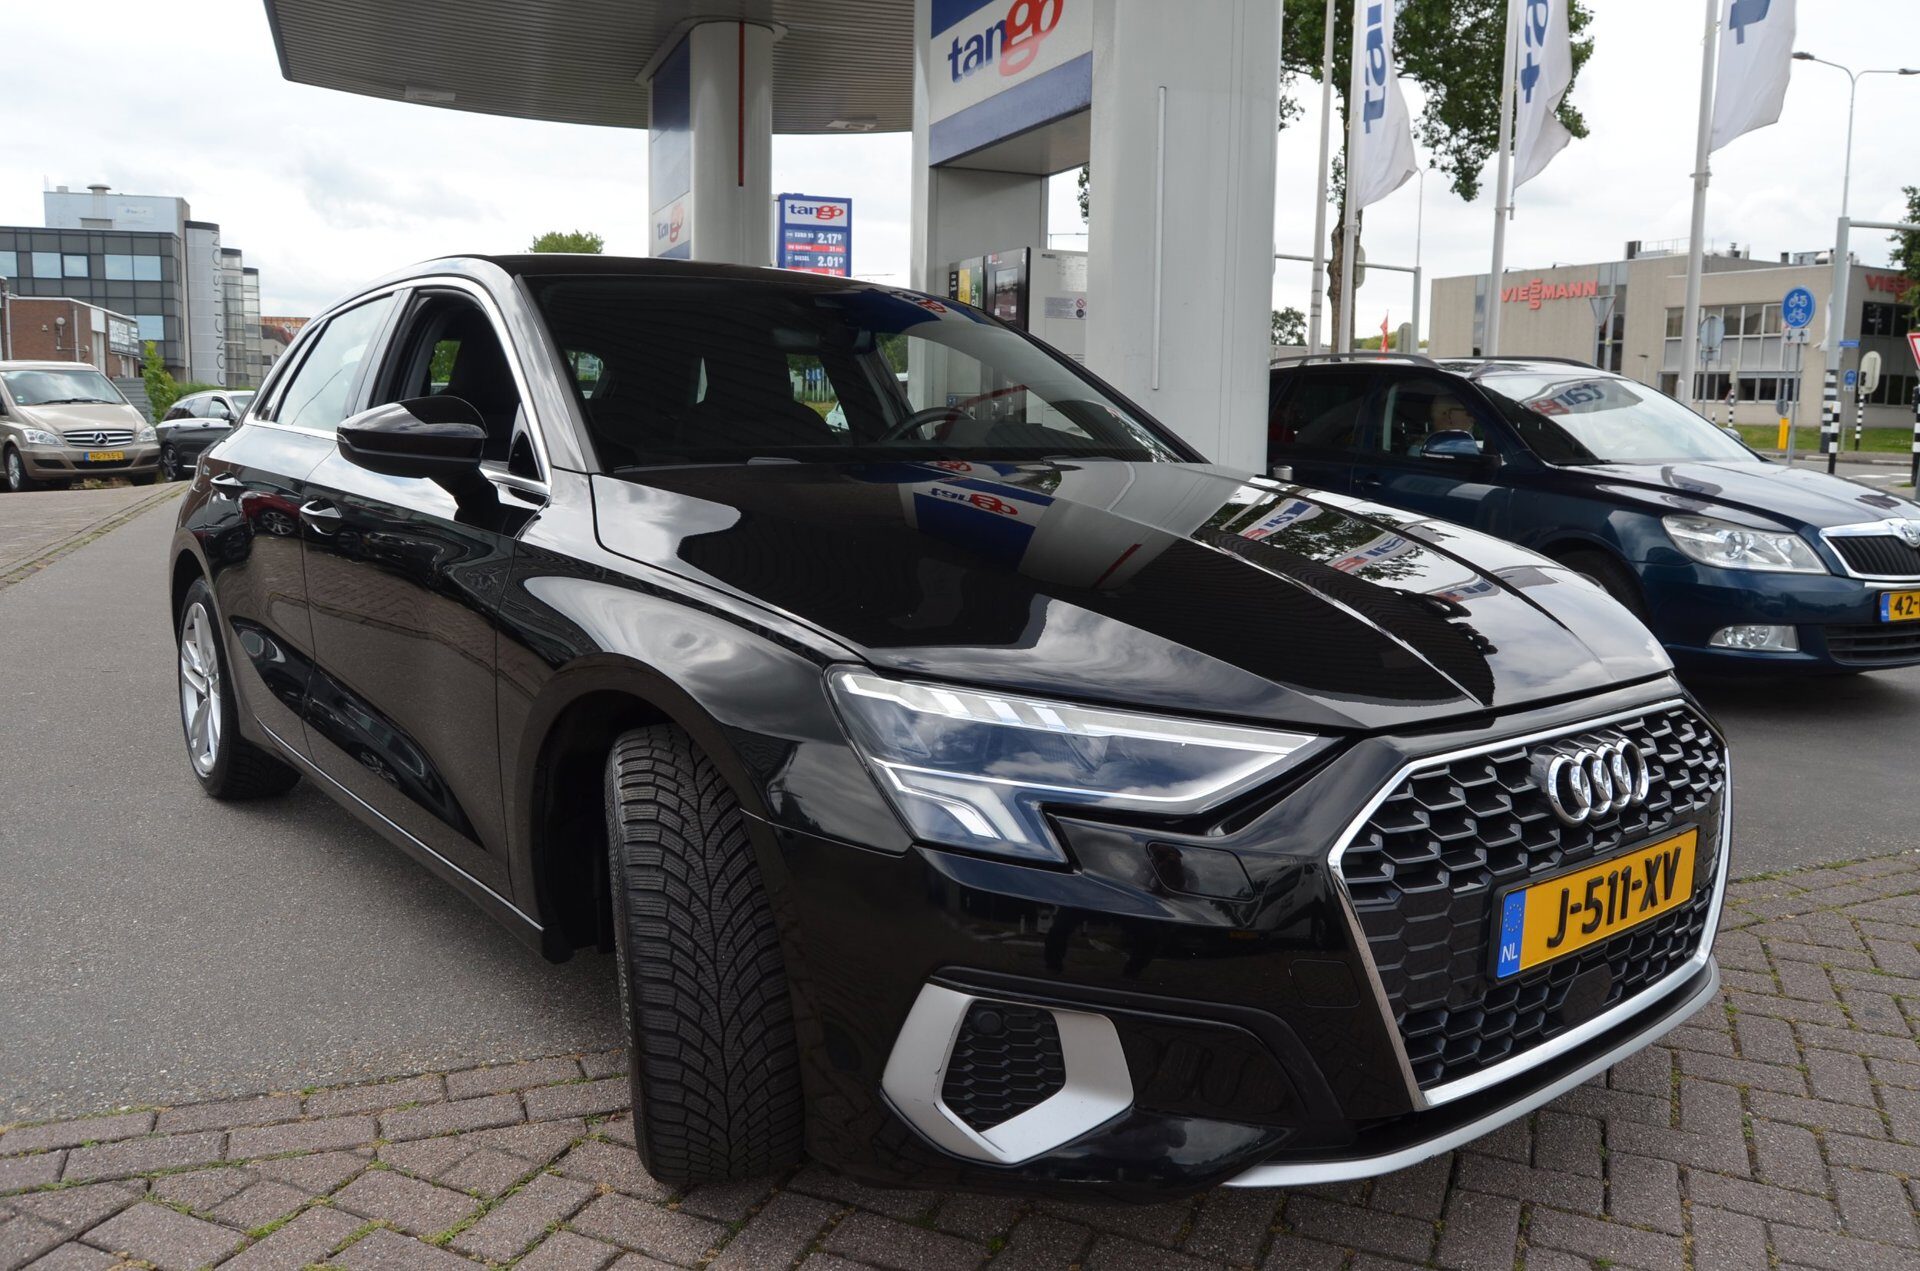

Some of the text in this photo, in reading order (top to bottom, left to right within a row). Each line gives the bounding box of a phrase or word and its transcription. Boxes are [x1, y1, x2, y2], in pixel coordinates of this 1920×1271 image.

[948, 0, 1064, 82] tango
[788, 203, 844, 220] tango
[1501, 278, 1598, 310] VIESSMANN
[1894, 595, 1920, 616] 42-
[1547, 847, 1681, 949] J-511-XV
[1501, 942, 1518, 963] NL
